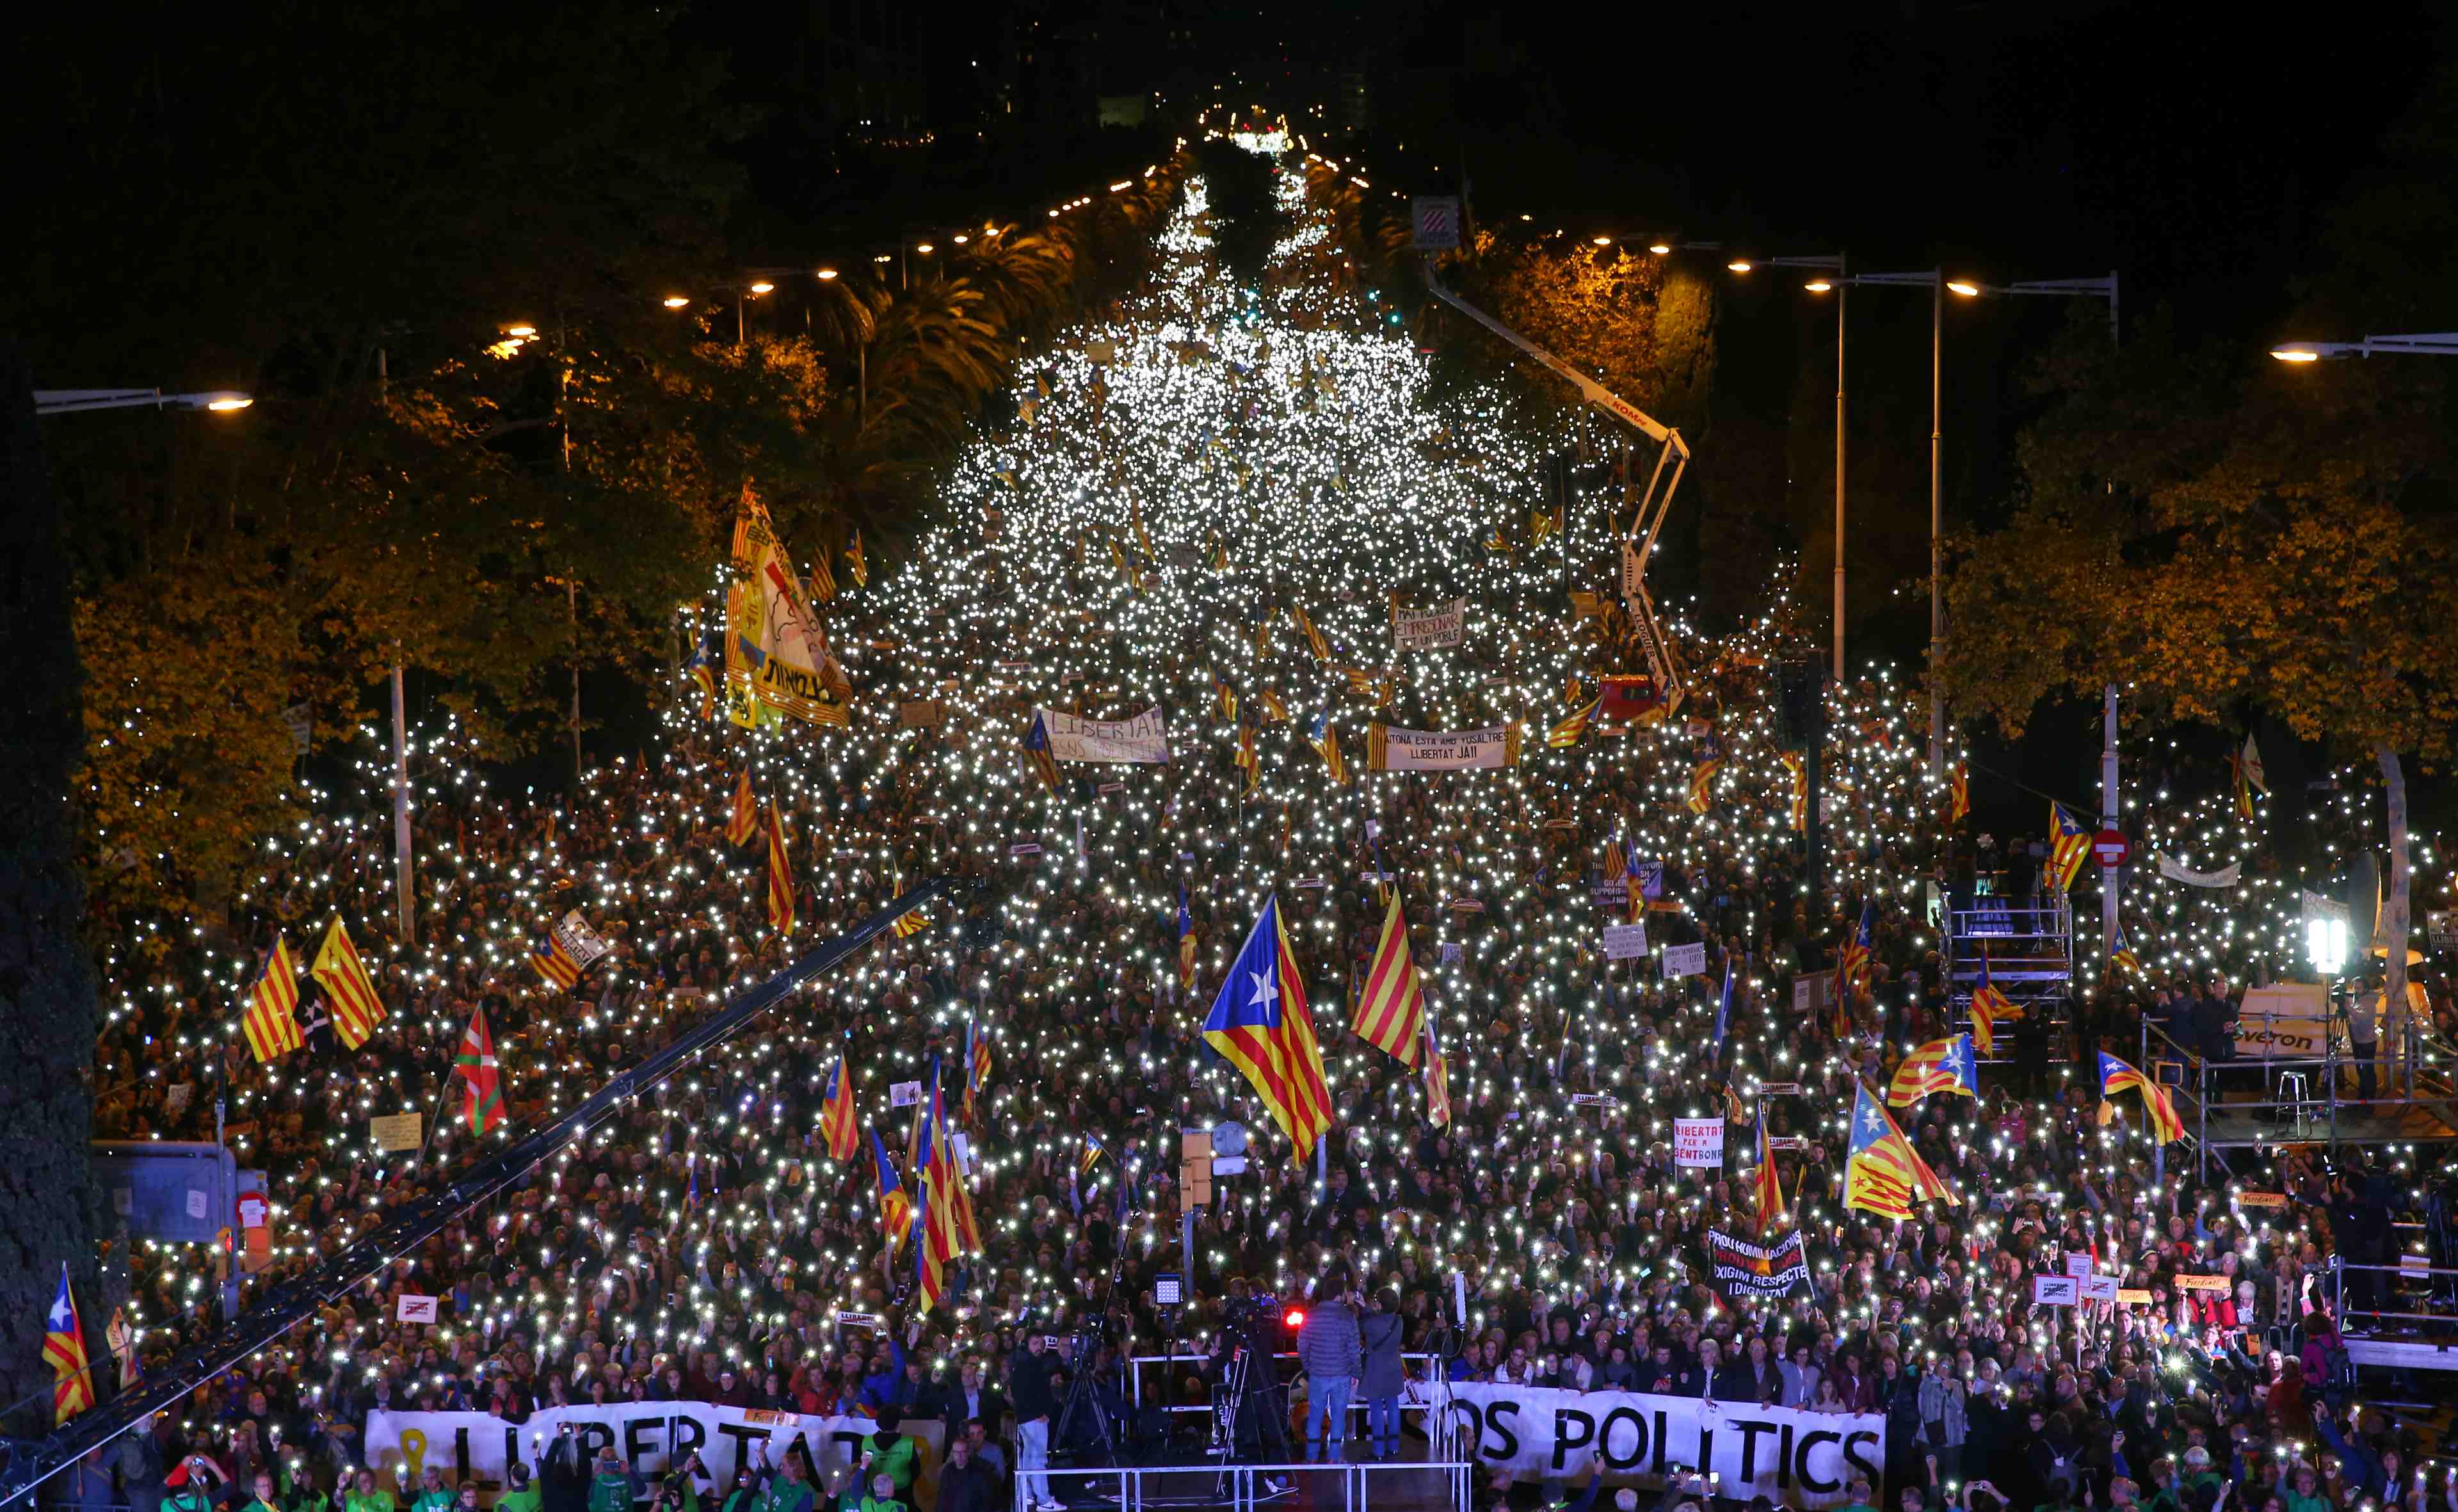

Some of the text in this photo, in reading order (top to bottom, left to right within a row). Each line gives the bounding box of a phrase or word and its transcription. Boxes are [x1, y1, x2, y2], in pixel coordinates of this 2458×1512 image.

[1396, 614, 1459, 636] EMPRESONAR
[1634, 613, 1656, 658] LLOGUER
[1411, 748, 1454, 759] LLIBERTAT
[1683, 1138, 1697, 1146] PER
[1708, 1230, 1735, 1250] PROU
